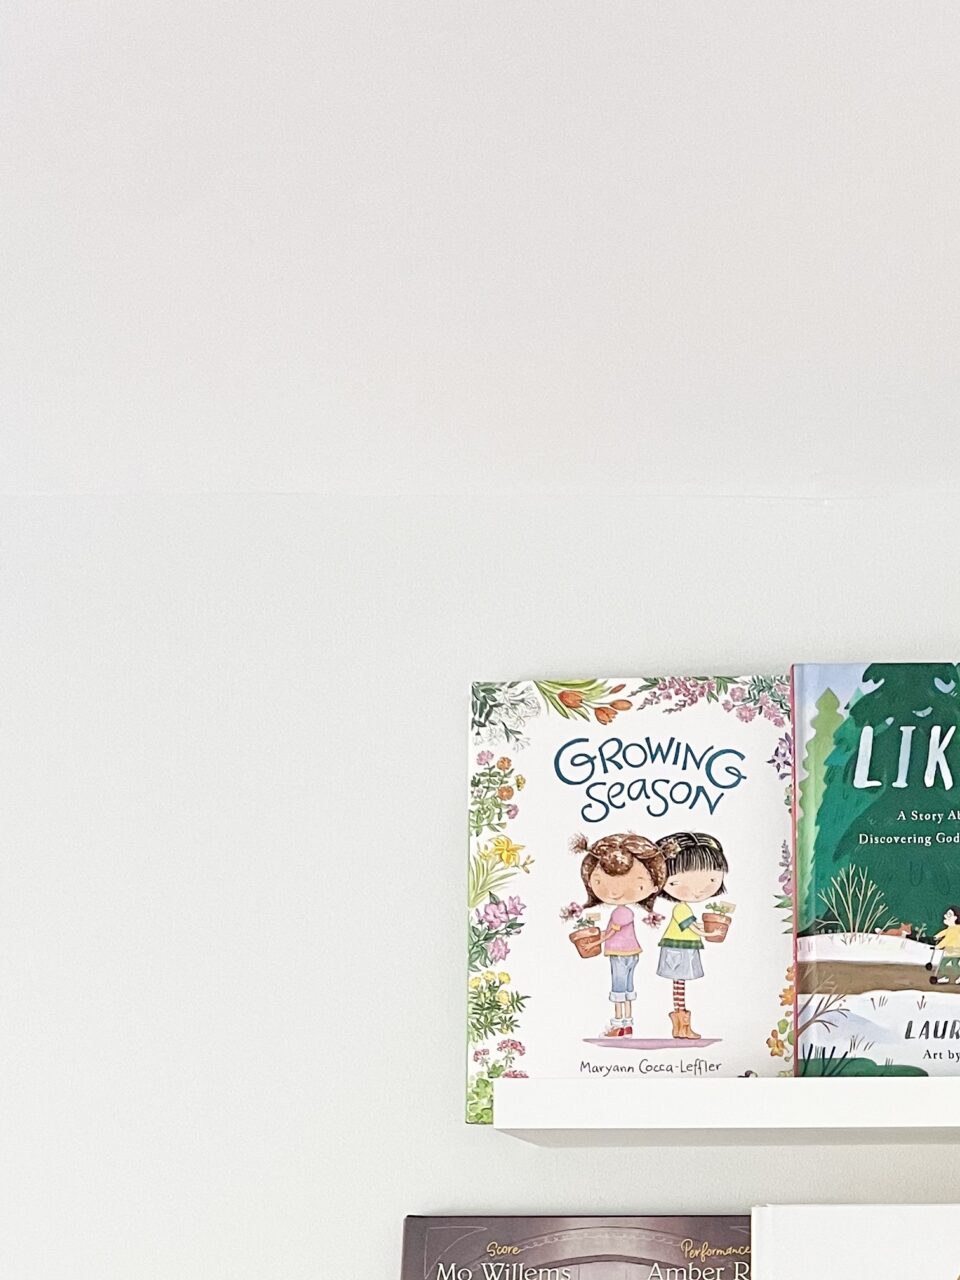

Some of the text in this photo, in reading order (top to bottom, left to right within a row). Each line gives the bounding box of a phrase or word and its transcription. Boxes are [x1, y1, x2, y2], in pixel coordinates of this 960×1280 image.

[553, 736, 747, 790] GROWING
[897, 810, 907, 821] A
[911, 809, 944, 823] Story
[859, 833, 932, 846] Discovering
[923, 1048, 943, 1060] Art
[580, 1059, 722, 1077] Maryann Cocca-Leffler
[487, 1242, 522, 1256] Score
